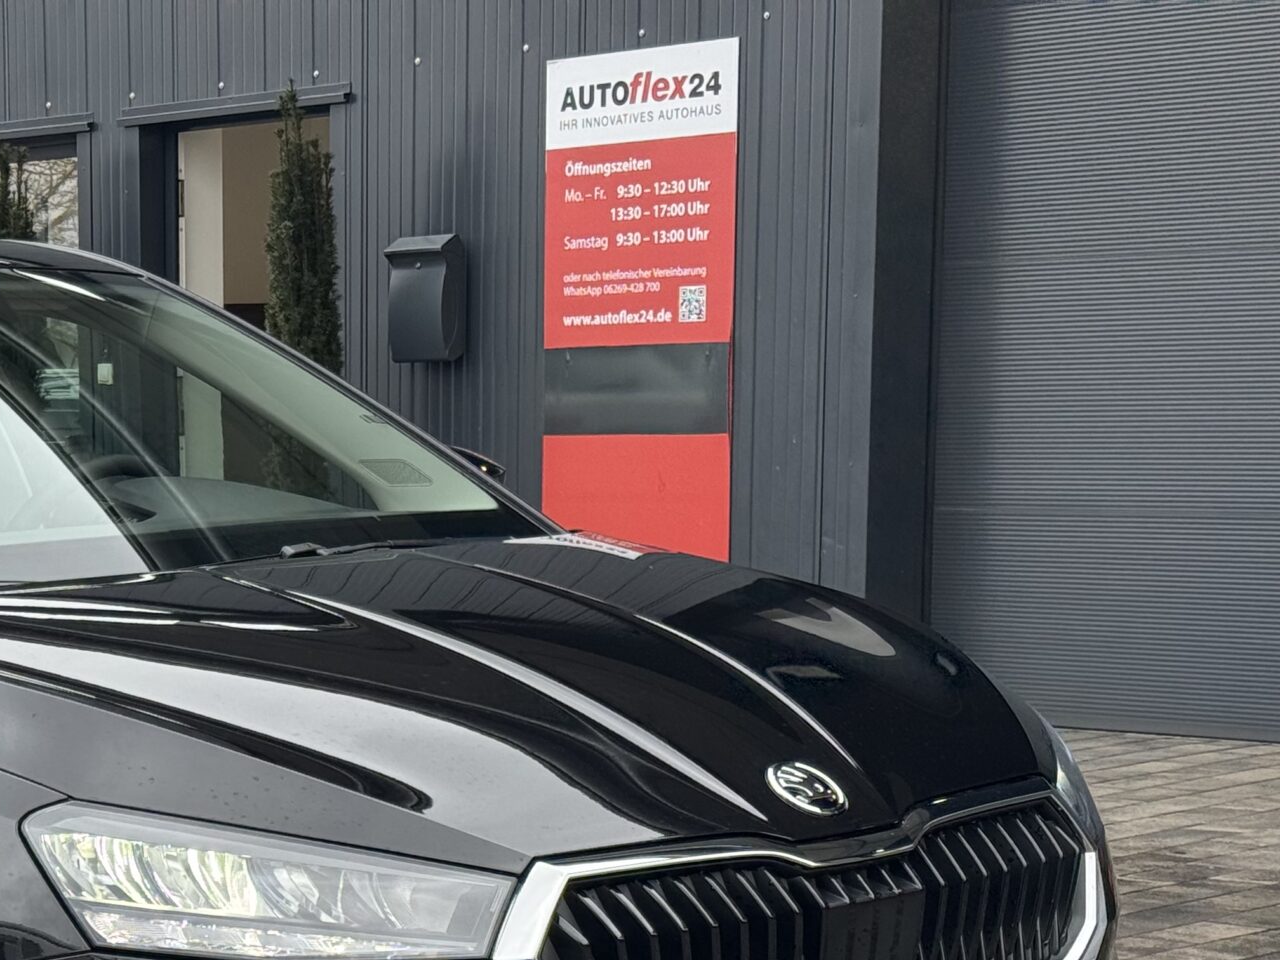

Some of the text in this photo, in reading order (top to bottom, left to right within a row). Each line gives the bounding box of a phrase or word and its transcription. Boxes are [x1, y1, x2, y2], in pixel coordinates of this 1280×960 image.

[560, 71, 722, 112] AUTOflex24
[559, 104, 722, 131] IHR INNOVATIVES AUTOHAUS
[565, 157, 652, 177] Öffnungszeiten
[564, 188, 584, 202] Mo.
[594, 186, 607, 200] Fr.
[617, 183, 642, 199] 9:30
[654, 180, 686, 196] 12:30
[687, 177, 711, 193] Uhr
[610, 206, 642, 221] 13:30
[653, 202, 686, 218] 17:00
[687, 201, 711, 216] Uhr
[564, 234, 609, 251] Samstag
[616, 231, 642, 247] 9:30
[652, 228, 685, 245] 13:00
[687, 227, 710, 242] Uhr
[563, 265, 707, 283] oder nach telefonischer Vereinbarung
[563, 284, 603, 298] WhatsApp
[645, 281, 661, 292] 700
[563, 308, 673, 327] www.autoflex24.de
